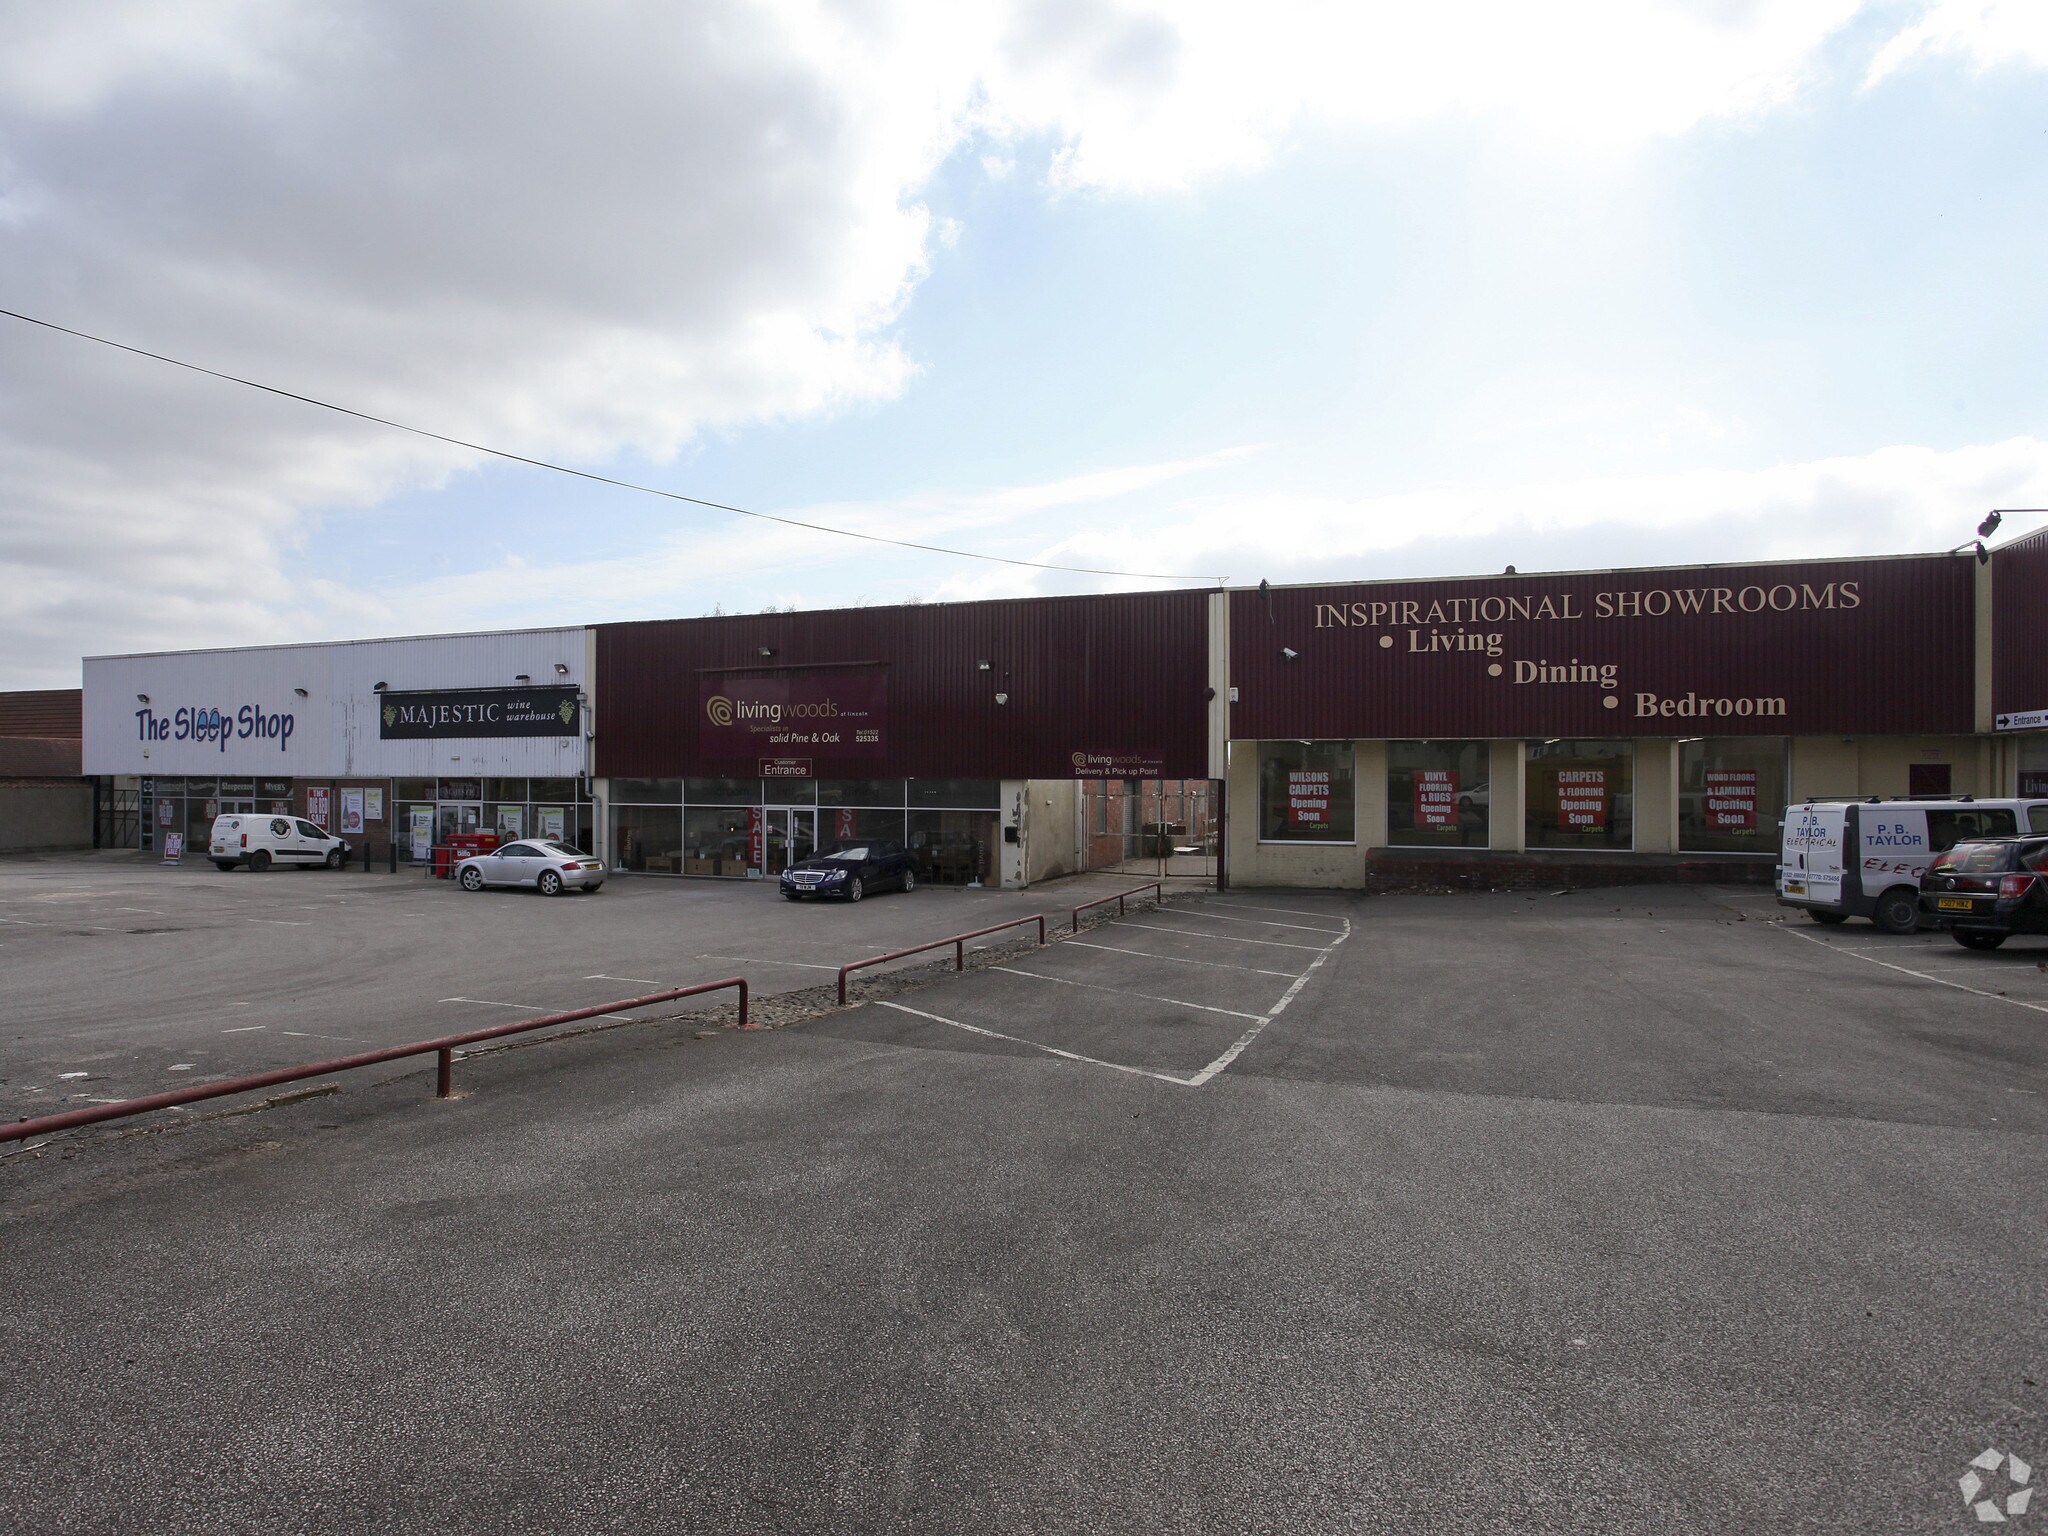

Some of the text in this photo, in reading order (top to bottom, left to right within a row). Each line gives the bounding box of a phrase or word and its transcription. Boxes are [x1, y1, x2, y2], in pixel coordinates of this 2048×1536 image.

[1314, 581, 1861, 629] INSPIRATIONAL SHOWROOMS
[1407, 628, 1503, 656] Living
[1513, 658, 1618, 688] Dining
[507, 700, 530, 710] wine
[737, 698, 837, 722] livingwoods
[1634, 692, 1787, 718] Bedroom
[400, 703, 499, 728] MAJESTIC
[506, 711, 555, 722] warehouse
[2014, 715, 2041, 726] Entrance
[136, 704, 294, 752] The Sleep Shop
[750, 725, 781, 733] Specialists
[770, 732, 840, 743] solid Pine & Oak
[765, 765, 806, 775] Entrance
[1075, 767, 1103, 776] Delivery
[1140, 767, 1158, 775] Point
[1289, 772, 1329, 782] WILSONS
[1424, 771, 1447, 781] VINYL
[1558, 771, 1604, 783] CARPETS
[1707, 773, 1755, 782] WOOD FLOORS
[1289, 785, 1329, 795] CARPETS
[1419, 783, 1453, 791] FLOORING
[2025, 777, 2048, 794] Livin
[1558, 787, 1604, 797] & FLOORING
[1707, 786, 1756, 796] & LAMINATE
[1421, 793, 1451, 802] & RUGS
[1291, 798, 1327, 810] Opening
[1420, 804, 1451, 813] Opening
[1560, 800, 1602, 812] Opening
[1709, 799, 1754, 812] Opening
[311, 814, 326, 825] SALE
[1298, 811, 1320, 821] Soon
[1426, 814, 1445, 823] Soon
[1568, 813, 1594, 824] Soon
[1717, 813, 1744, 824] Soon
[1802, 816, 1819, 826] P. B.
[841, 809, 852, 837] SA
[1309, 822, 1328, 830] Carpets
[1436, 824, 1457, 832] Carpets
[1582, 825, 1604, 834] Carpets
[1732, 827, 1755, 836] Carpets
[1796, 827, 1826, 837] TAYLOR
[1877, 824, 1909, 834] P. B.
[752, 807, 762, 863] SALE
[1786, 837, 1838, 847] ELECTRICAL
[1866, 835, 1922, 846] TAYLOR
